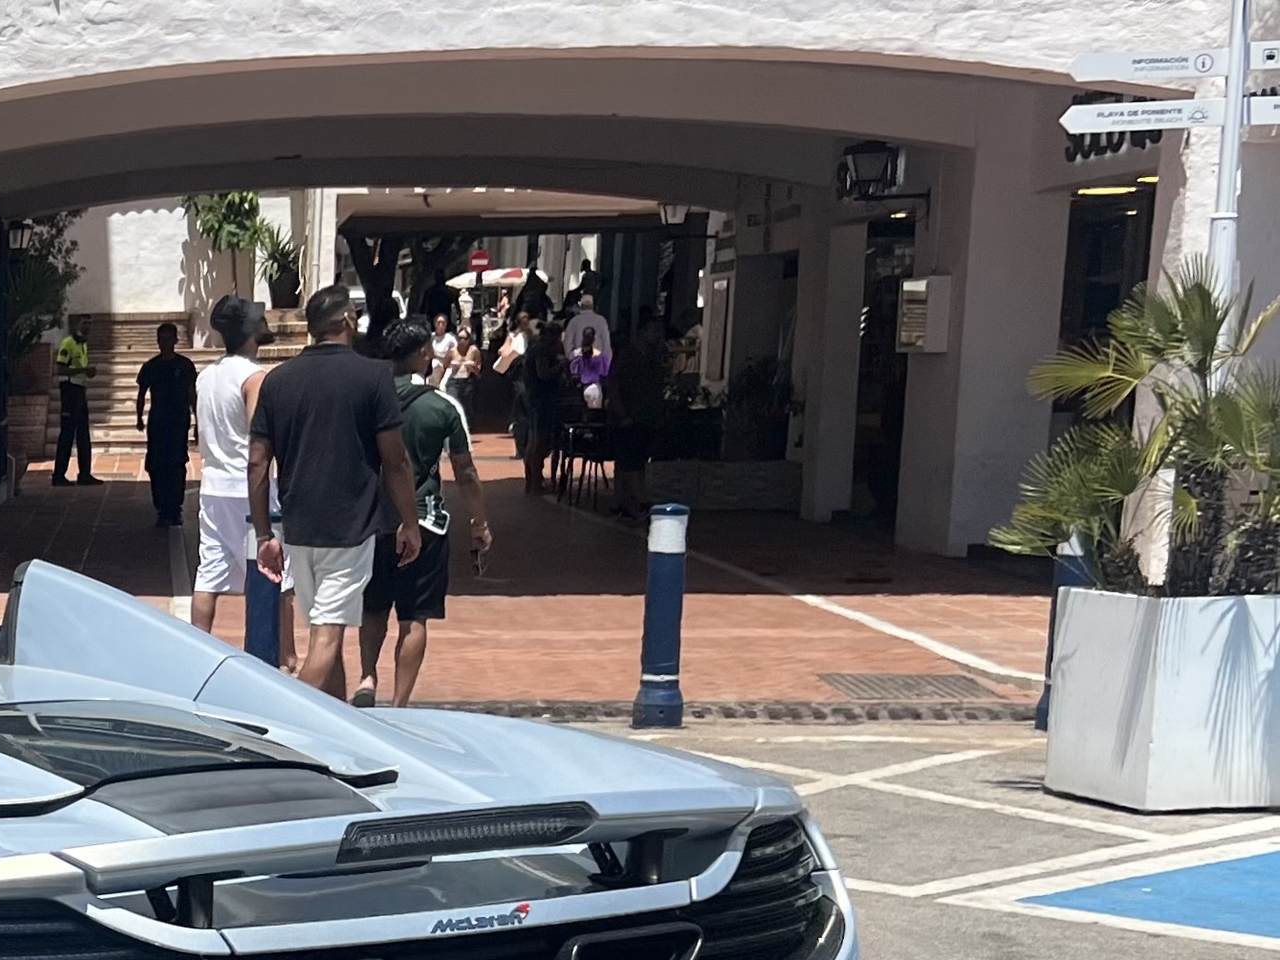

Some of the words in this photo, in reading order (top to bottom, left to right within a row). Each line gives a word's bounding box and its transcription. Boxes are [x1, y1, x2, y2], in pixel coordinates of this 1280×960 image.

[1127, 109, 1139, 117] DE
[1140, 108, 1183, 116] PONIENTE
[430, 913, 523, 934] McLaren
